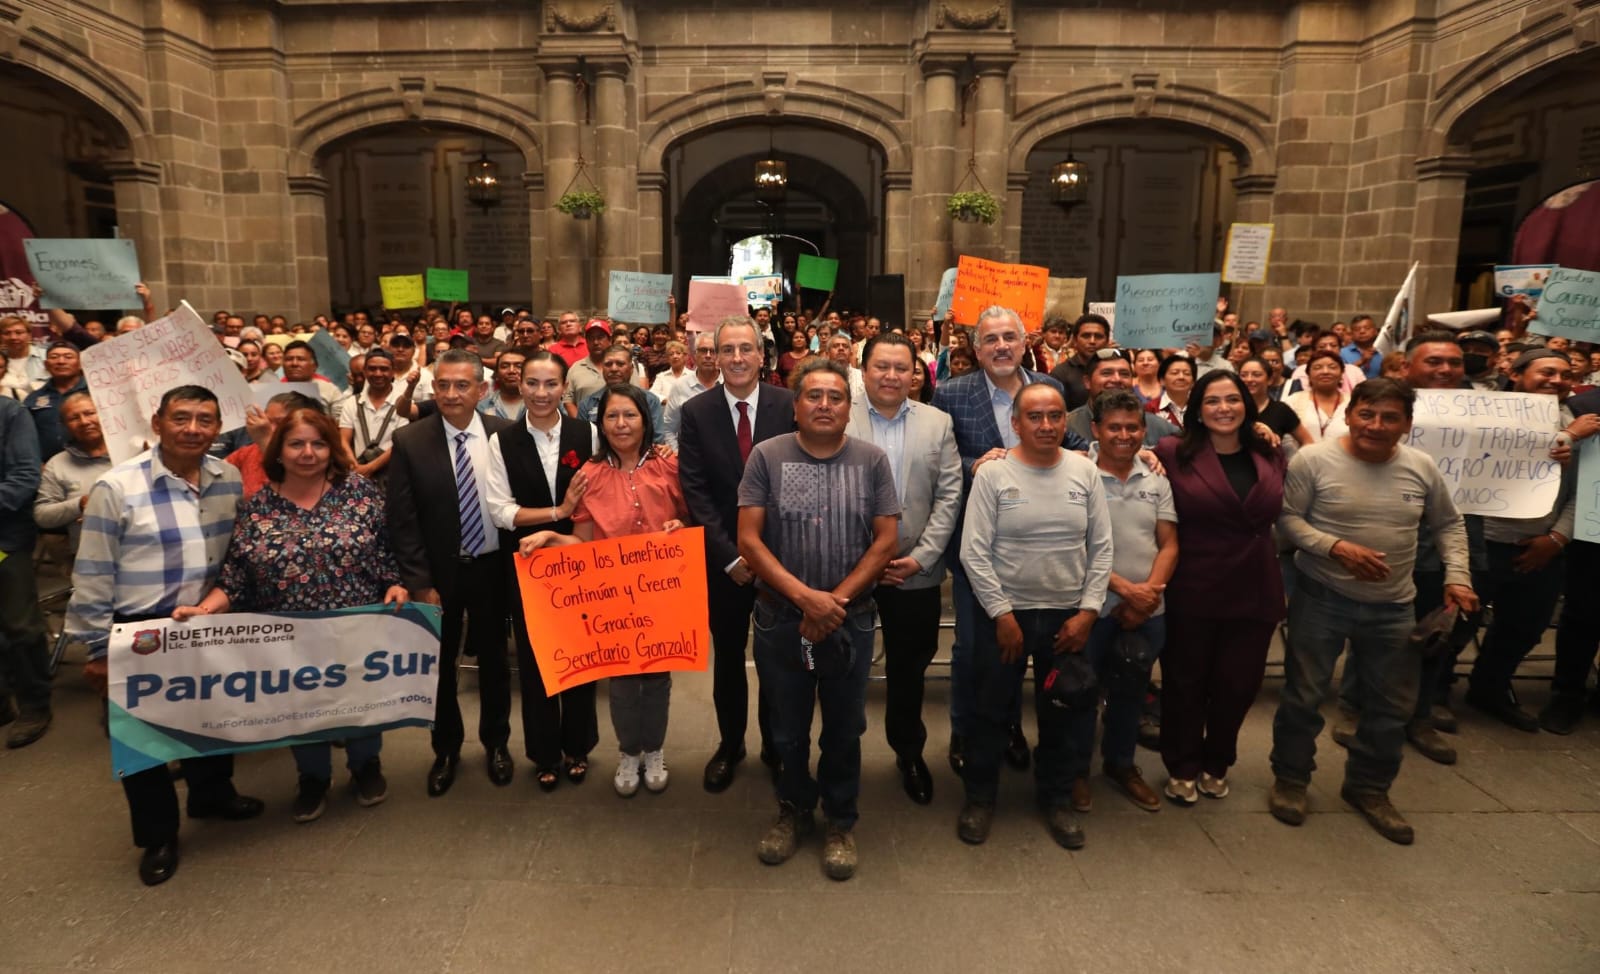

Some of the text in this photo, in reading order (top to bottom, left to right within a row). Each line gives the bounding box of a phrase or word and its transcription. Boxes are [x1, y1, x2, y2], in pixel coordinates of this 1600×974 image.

[1439, 427, 1465, 449] TU
[1453, 487, 1510, 511] ONOS
[529, 540, 684, 580] Contigo los beneficios
[624, 585, 635, 605] y
[168, 623, 295, 641] SUETHAPIPOPD
[168, 633, 295, 650] Lic. Benito Juárez García
[553, 629, 698, 673] Secretario Gonzalo!
[126, 649, 437, 709] Parques Sur
[399, 694, 433, 705] TODOS
